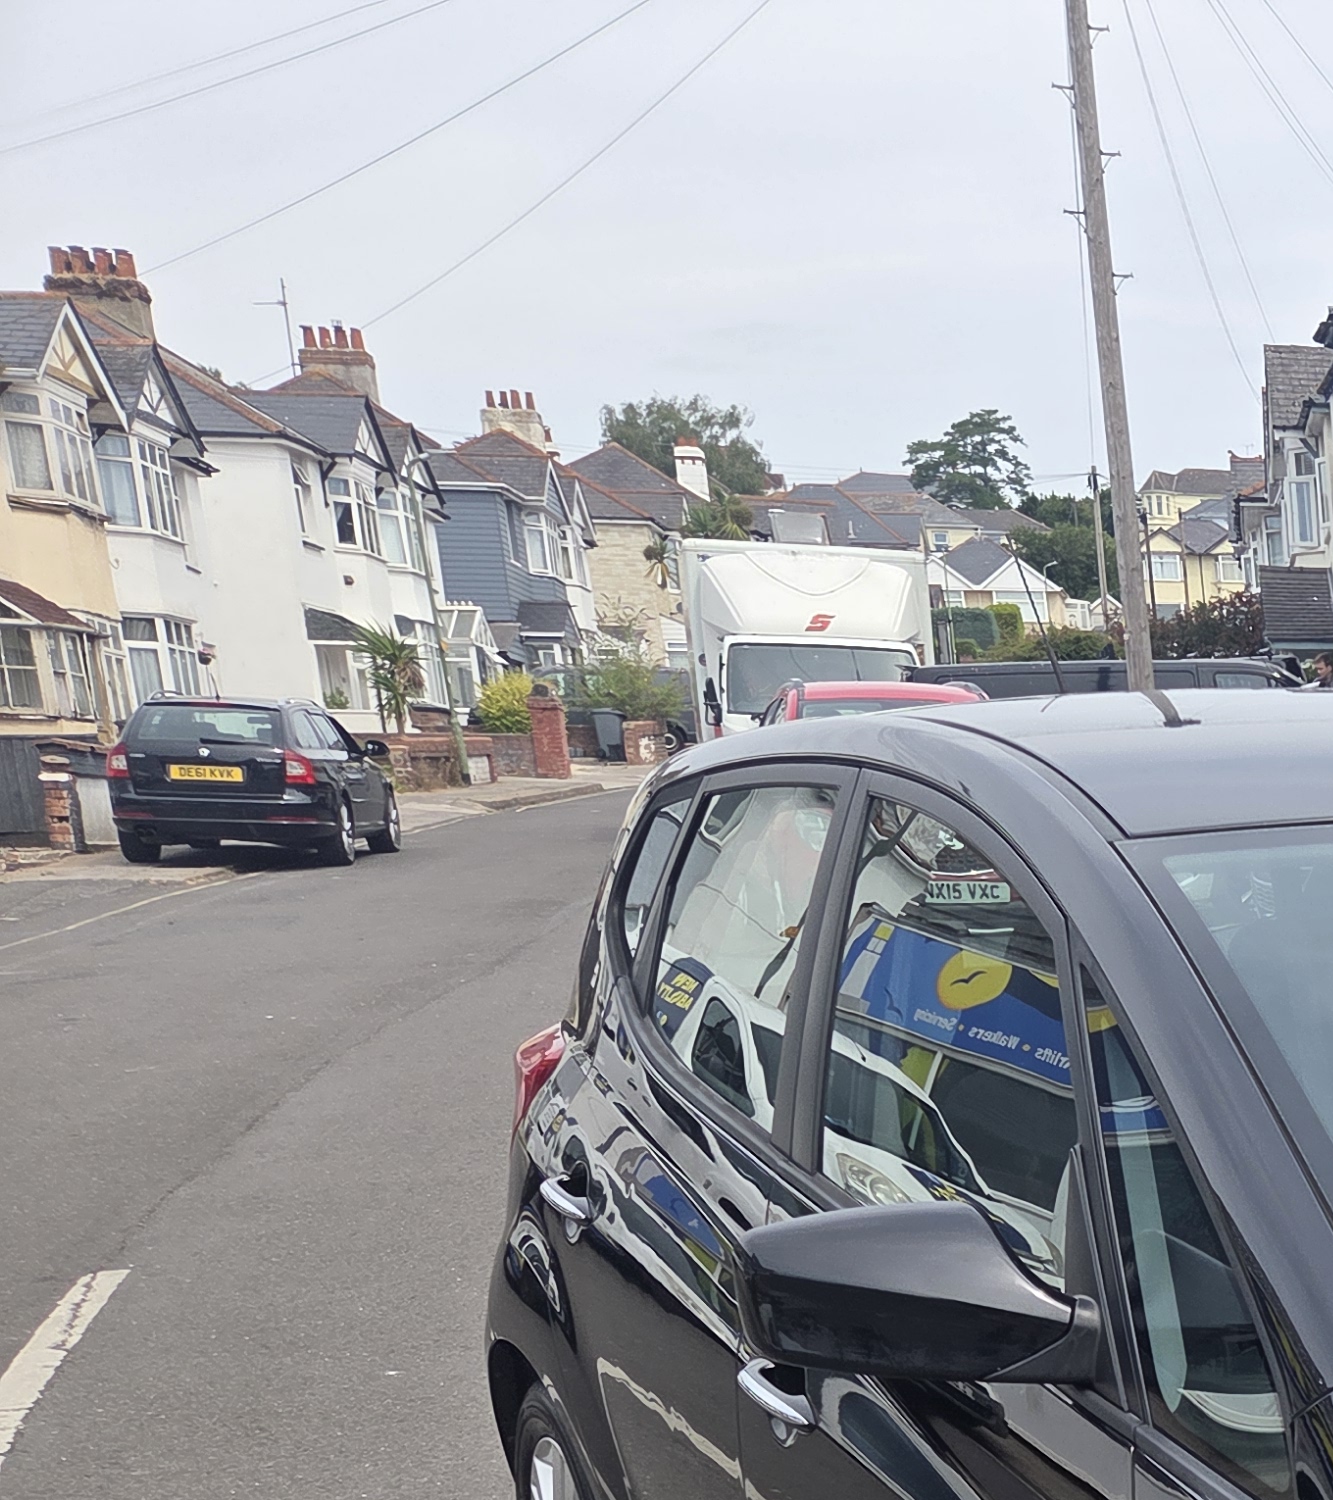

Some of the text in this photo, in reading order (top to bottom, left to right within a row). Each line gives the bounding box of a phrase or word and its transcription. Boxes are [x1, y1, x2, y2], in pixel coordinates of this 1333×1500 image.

[178, 766, 235, 779] DE61 KVK
[967, 882, 1001, 900] VXC
